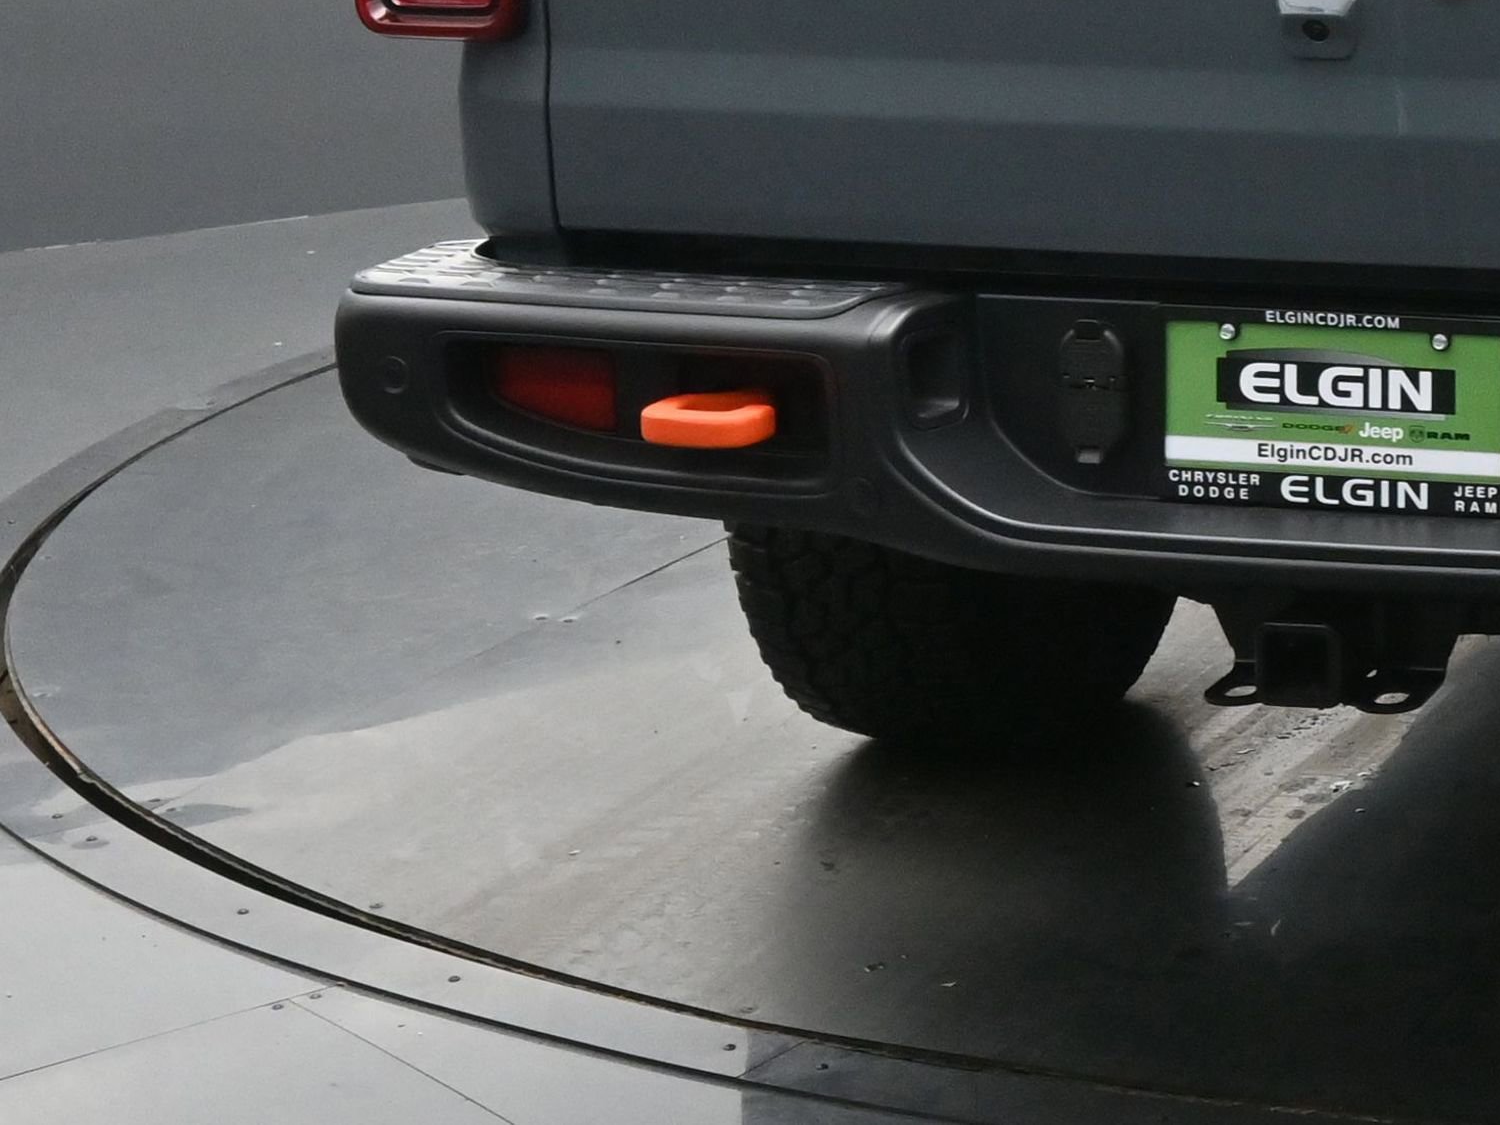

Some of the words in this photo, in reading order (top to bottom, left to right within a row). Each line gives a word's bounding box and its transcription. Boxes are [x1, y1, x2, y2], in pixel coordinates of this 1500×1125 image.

[1265, 310, 1400, 329] ELGINCDJR.COM
[1238, 362, 1433, 412] ELGIN
[1358, 422, 1404, 442] Jeep
[1426, 431, 1471, 441] RAM
[1257, 442, 1413, 466] ElginCDJR.com
[1168, 469, 1260, 486] CHRYSLER
[1178, 485, 1250, 500] DODGE
[1280, 475, 1428, 510] ELGIN
[1453, 485, 1498, 499] JEEP
[1454, 500, 1498, 514] RAM
